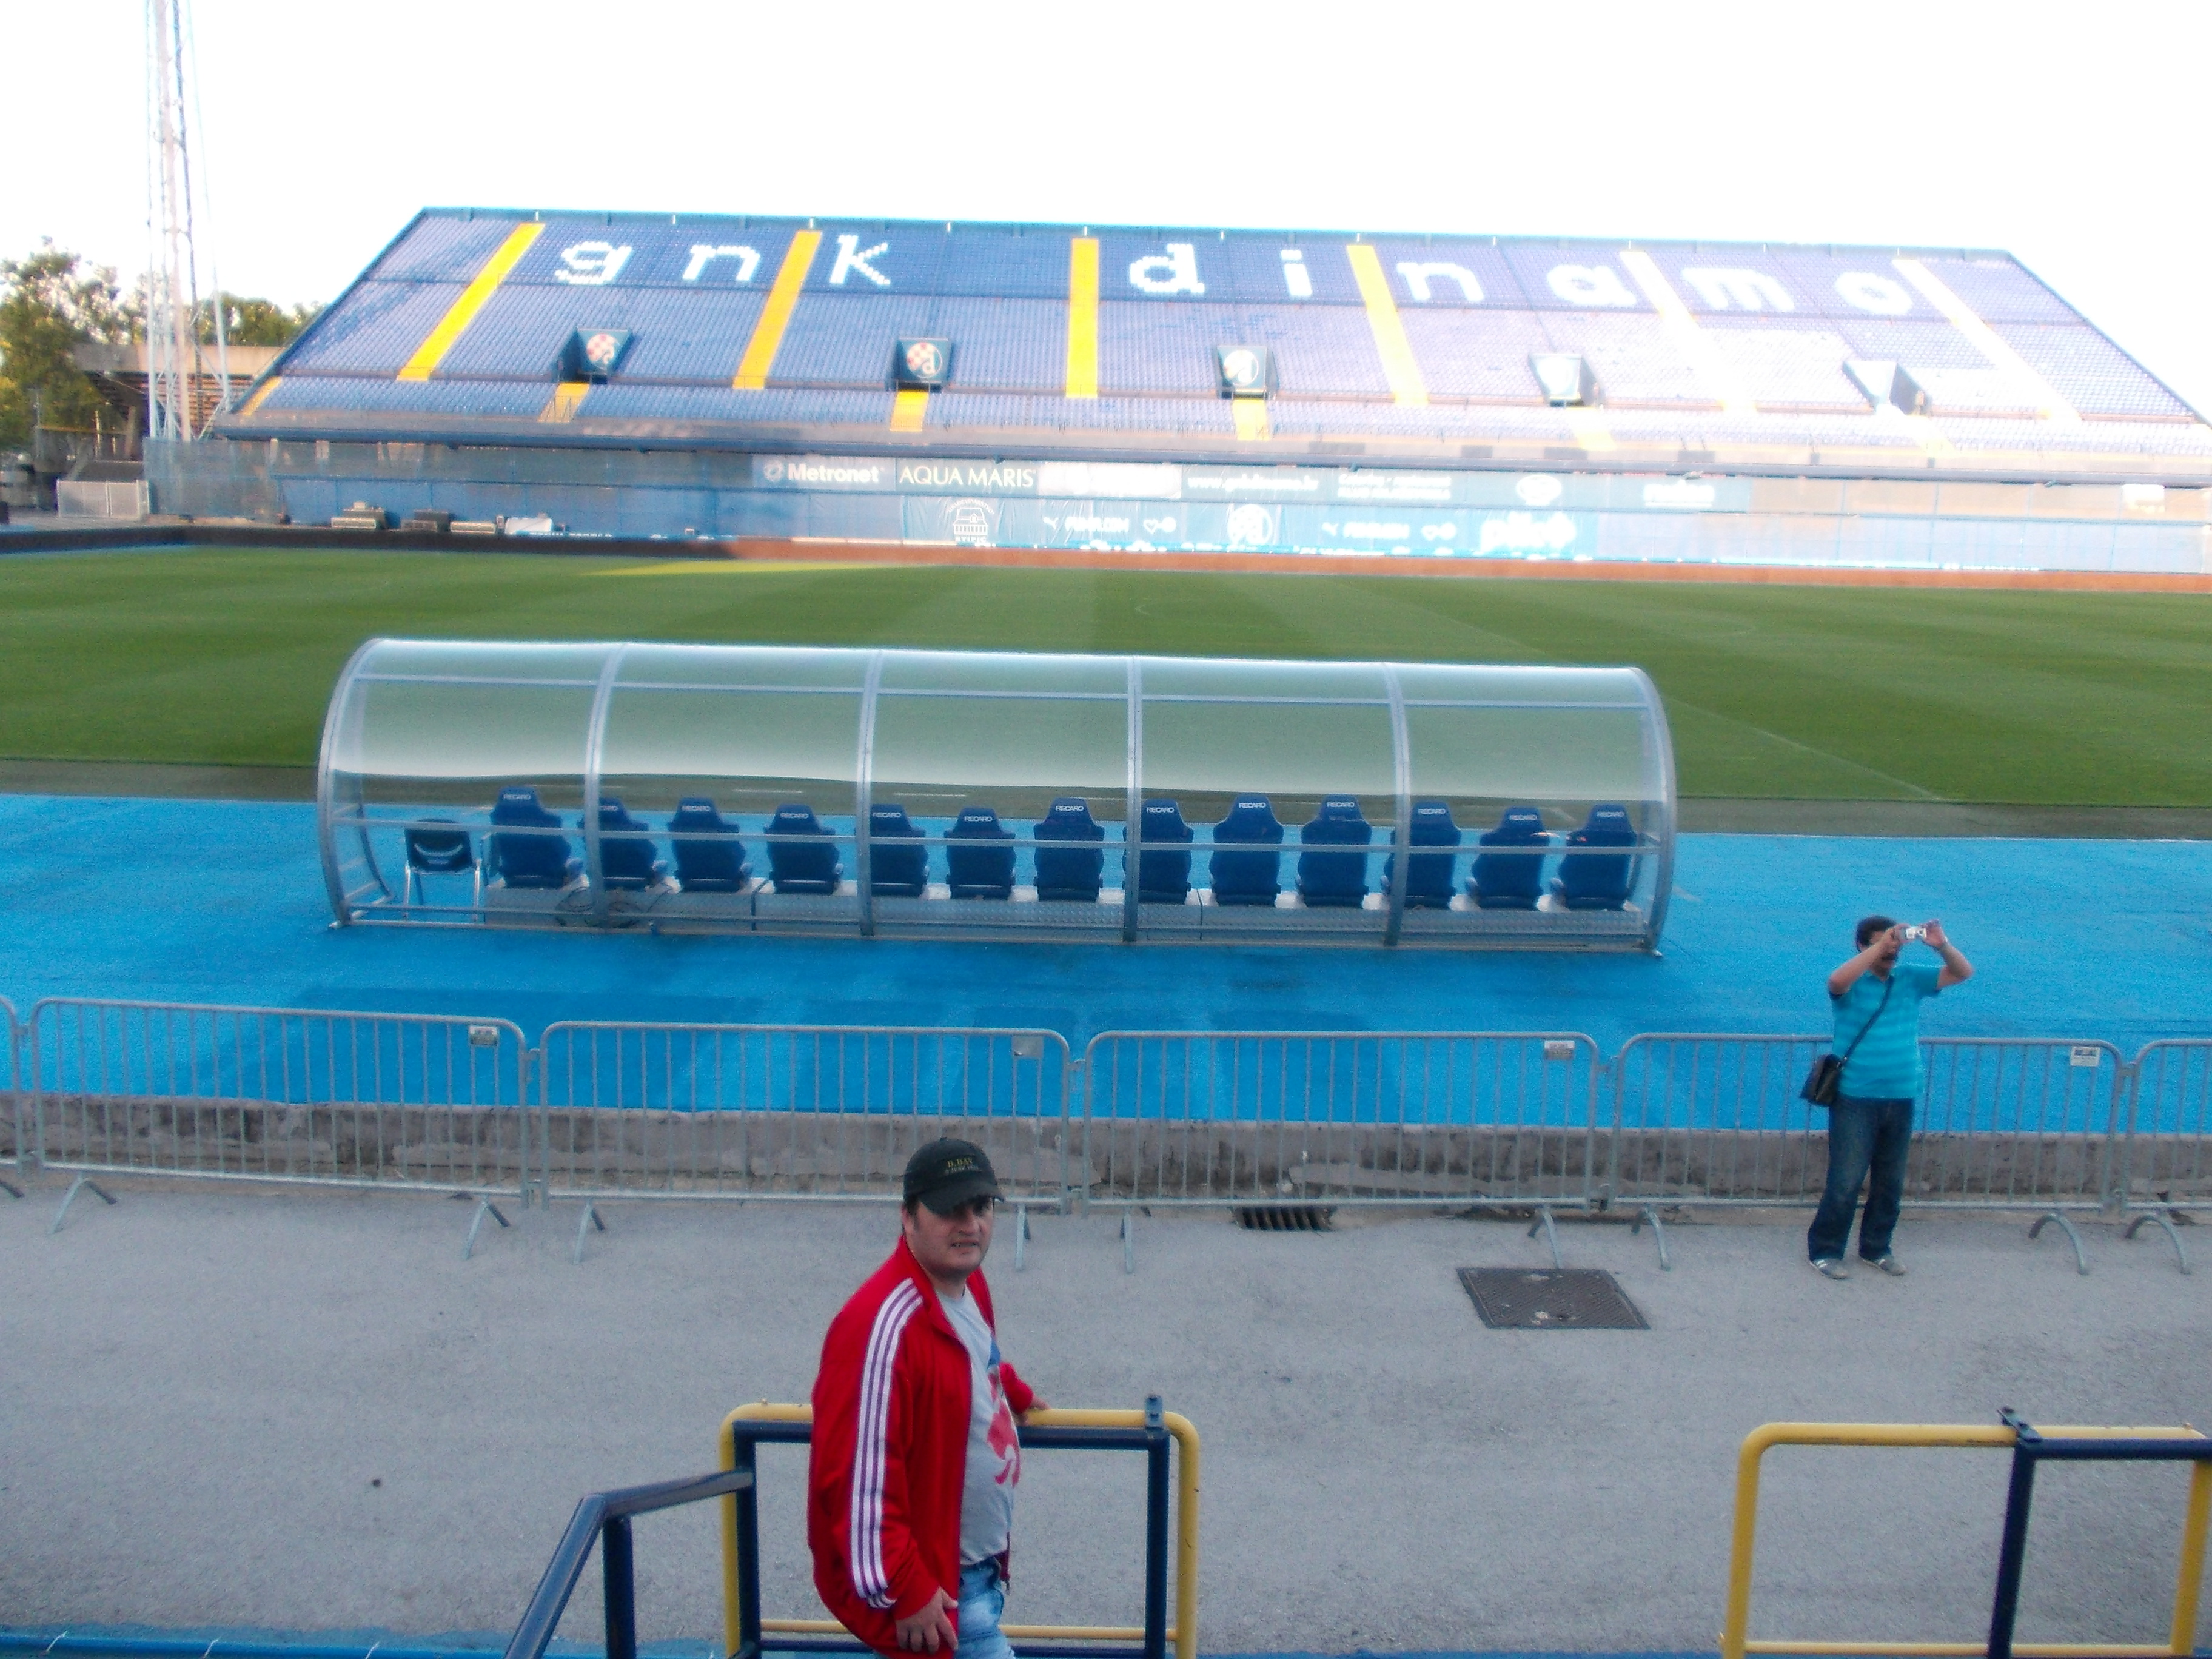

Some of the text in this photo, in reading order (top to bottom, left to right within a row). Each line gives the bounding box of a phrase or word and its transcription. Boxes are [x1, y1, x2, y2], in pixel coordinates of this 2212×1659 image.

[554, 234, 1914, 316] gnk dinamo
[788, 463, 879, 483] Metronet
[899, 466, 1034, 487] AQUA MARIS
